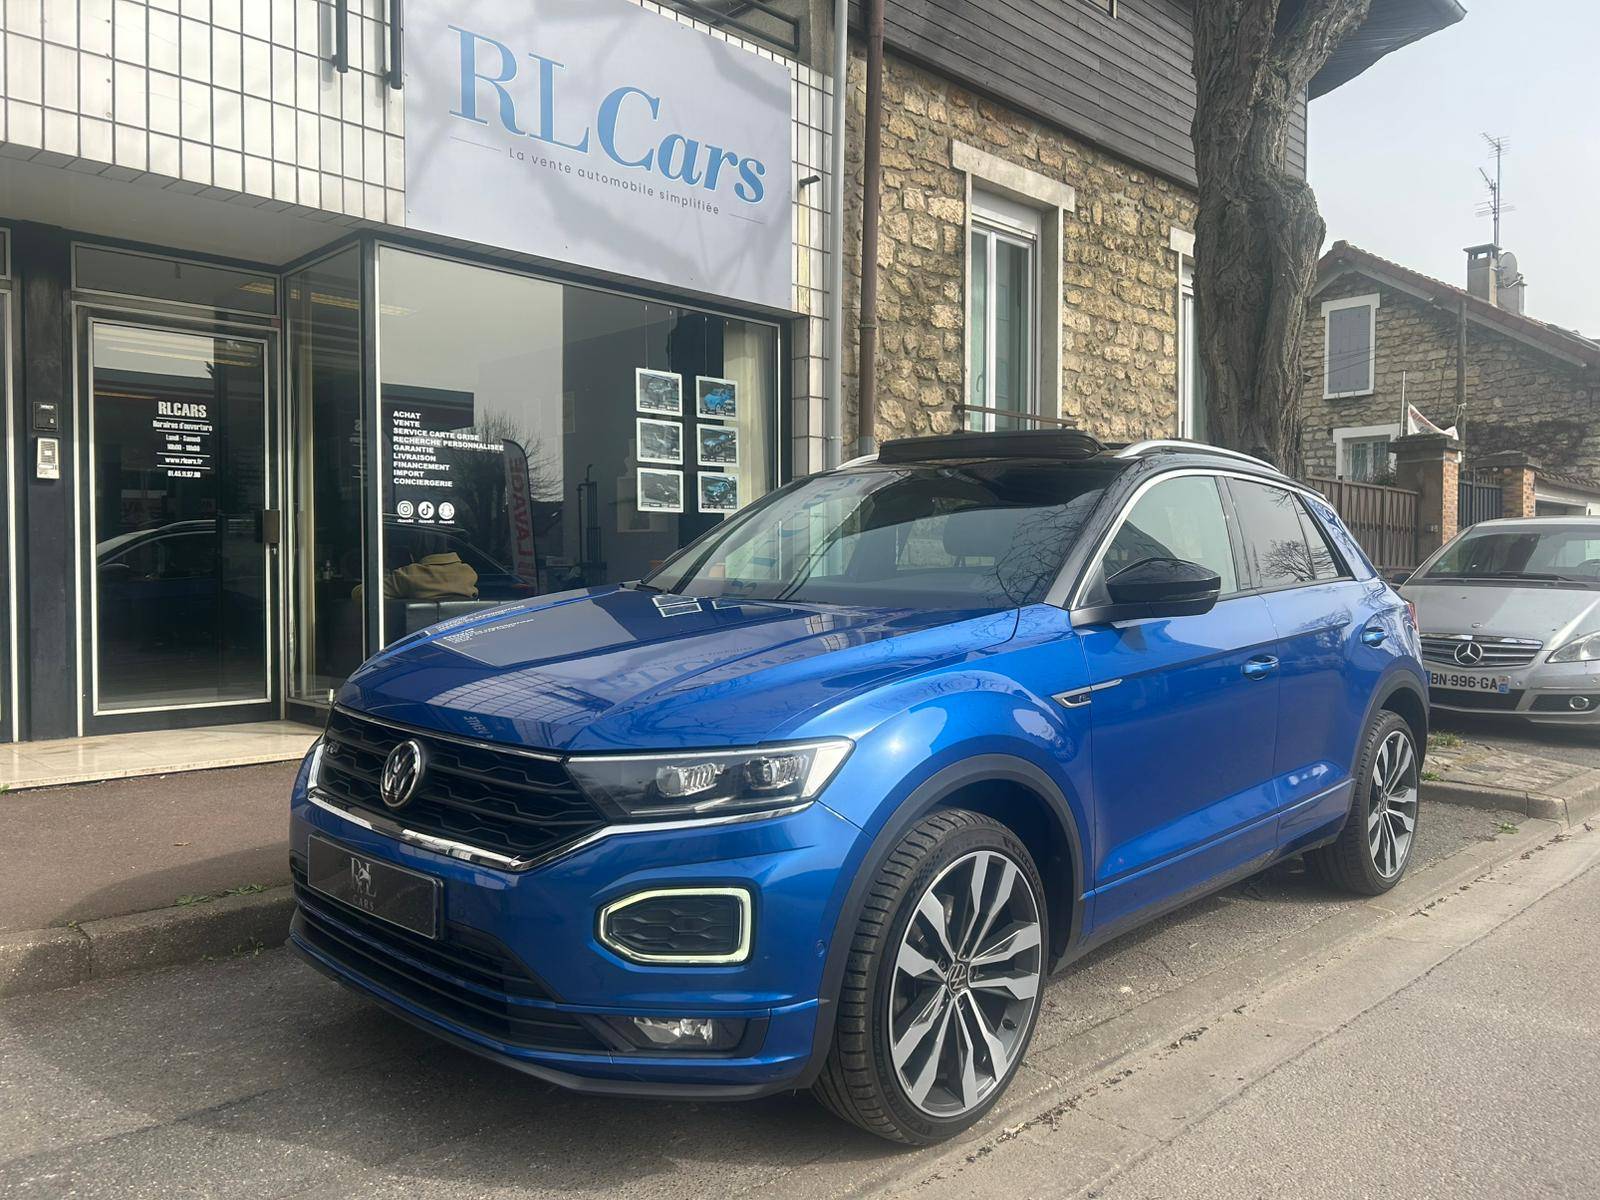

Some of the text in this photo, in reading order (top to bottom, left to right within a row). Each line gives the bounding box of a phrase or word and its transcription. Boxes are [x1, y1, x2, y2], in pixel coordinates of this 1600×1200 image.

[447, 24, 767, 204] RLCars
[509, 147, 720, 215] La vente automobile simplifiée
[158, 401, 207, 417] RLCARS
[393, 410, 421, 419] ACHAT
[393, 419, 420, 428] VENTE
[393, 427, 480, 441] SERVICE CARTE GRISE
[393, 436, 442, 447] RECHERCHE
[393, 444, 434, 454] GARANTIE
[393, 452, 437, 462] LIVRAISON
[393, 461, 450, 471] FINANCEMENT
[393, 469, 425, 478] IMPORT
[393, 477, 453, 488] CONCIERGERIE
[1431, 672, 1498, 690] BN-996-GA
